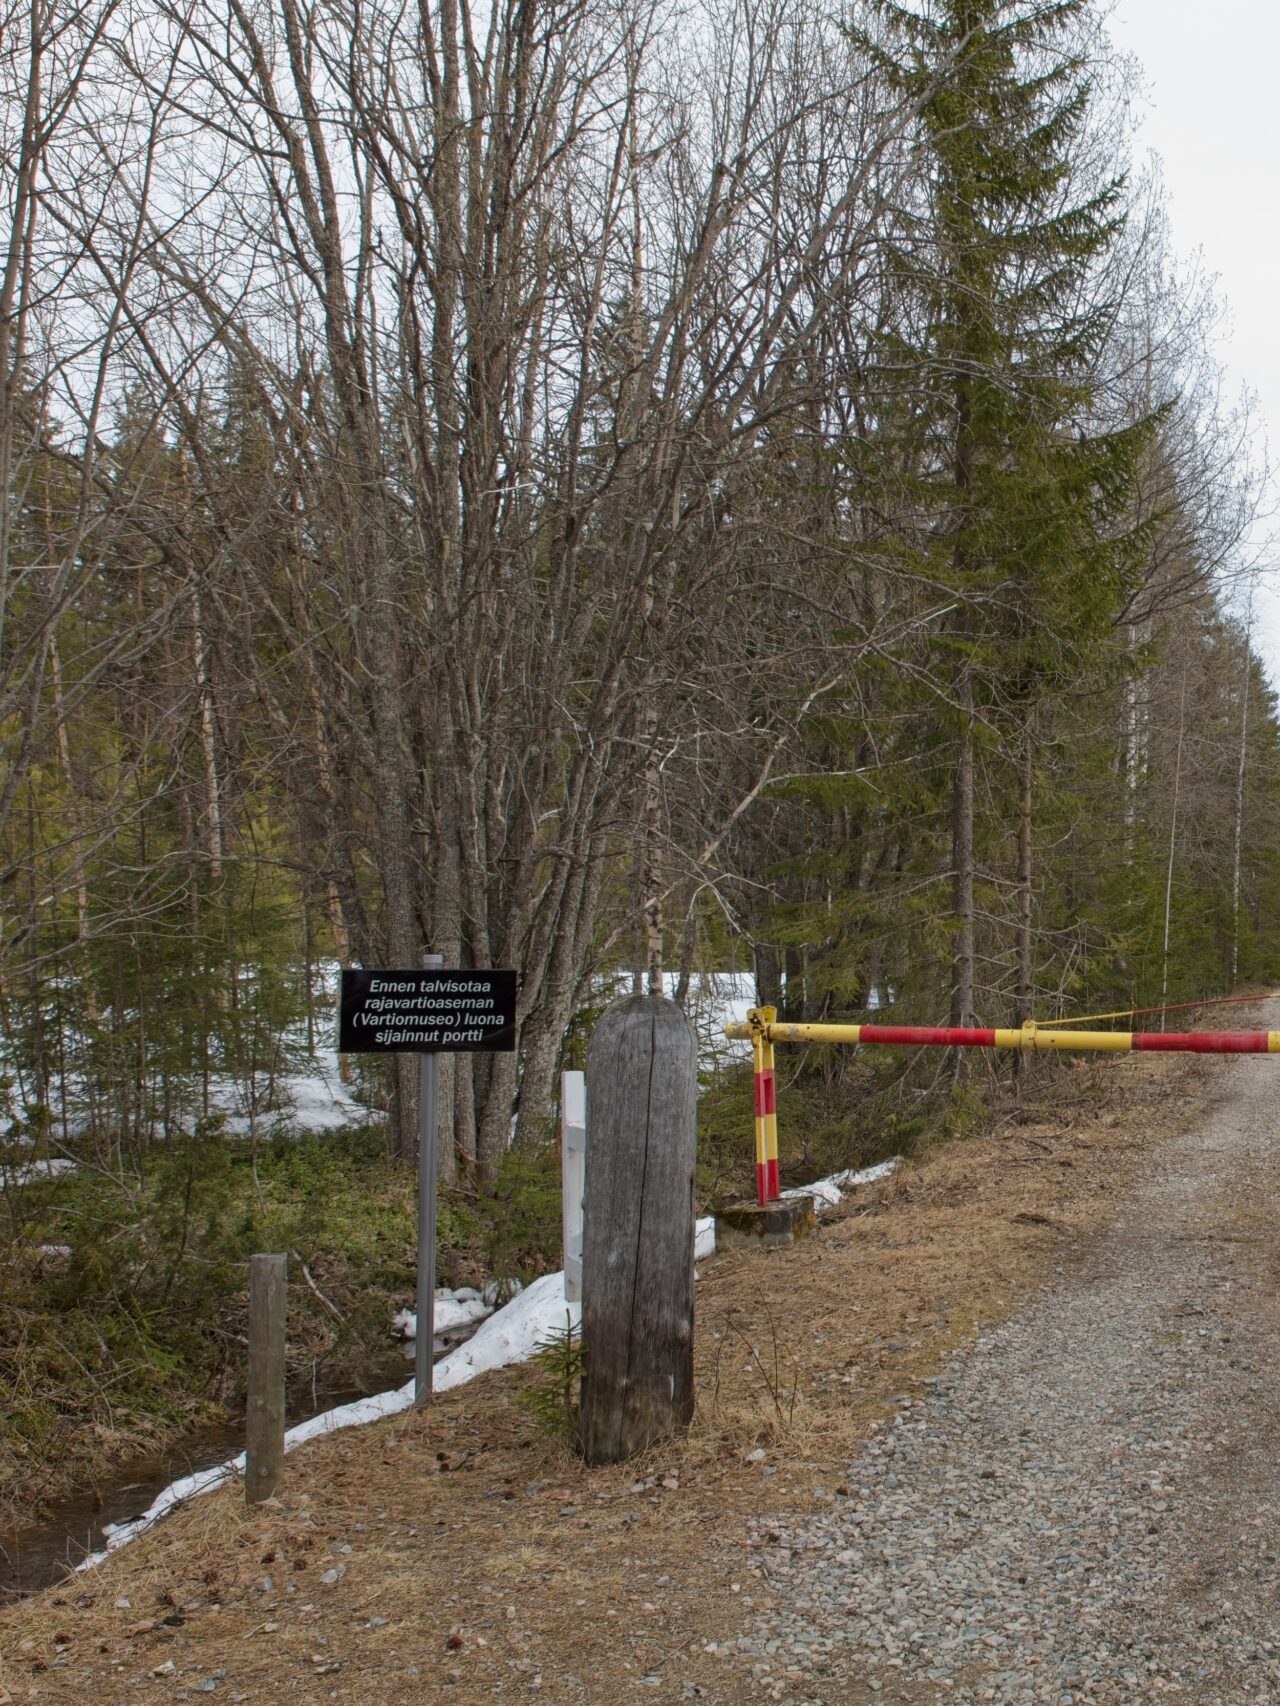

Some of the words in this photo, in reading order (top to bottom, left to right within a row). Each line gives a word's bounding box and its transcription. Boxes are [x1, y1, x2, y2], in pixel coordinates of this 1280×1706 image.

[370, 980, 416, 993] Ennen
[420, 980, 491, 993] talvisotaa
[364, 997, 494, 1011] rajavartioaseman
[353, 1012, 461, 1027] (Vartiomuseo)
[464, 1013, 505, 1026] luona
[375, 1029, 439, 1044] sijainnut
[442, 1029, 483, 1044] portti
